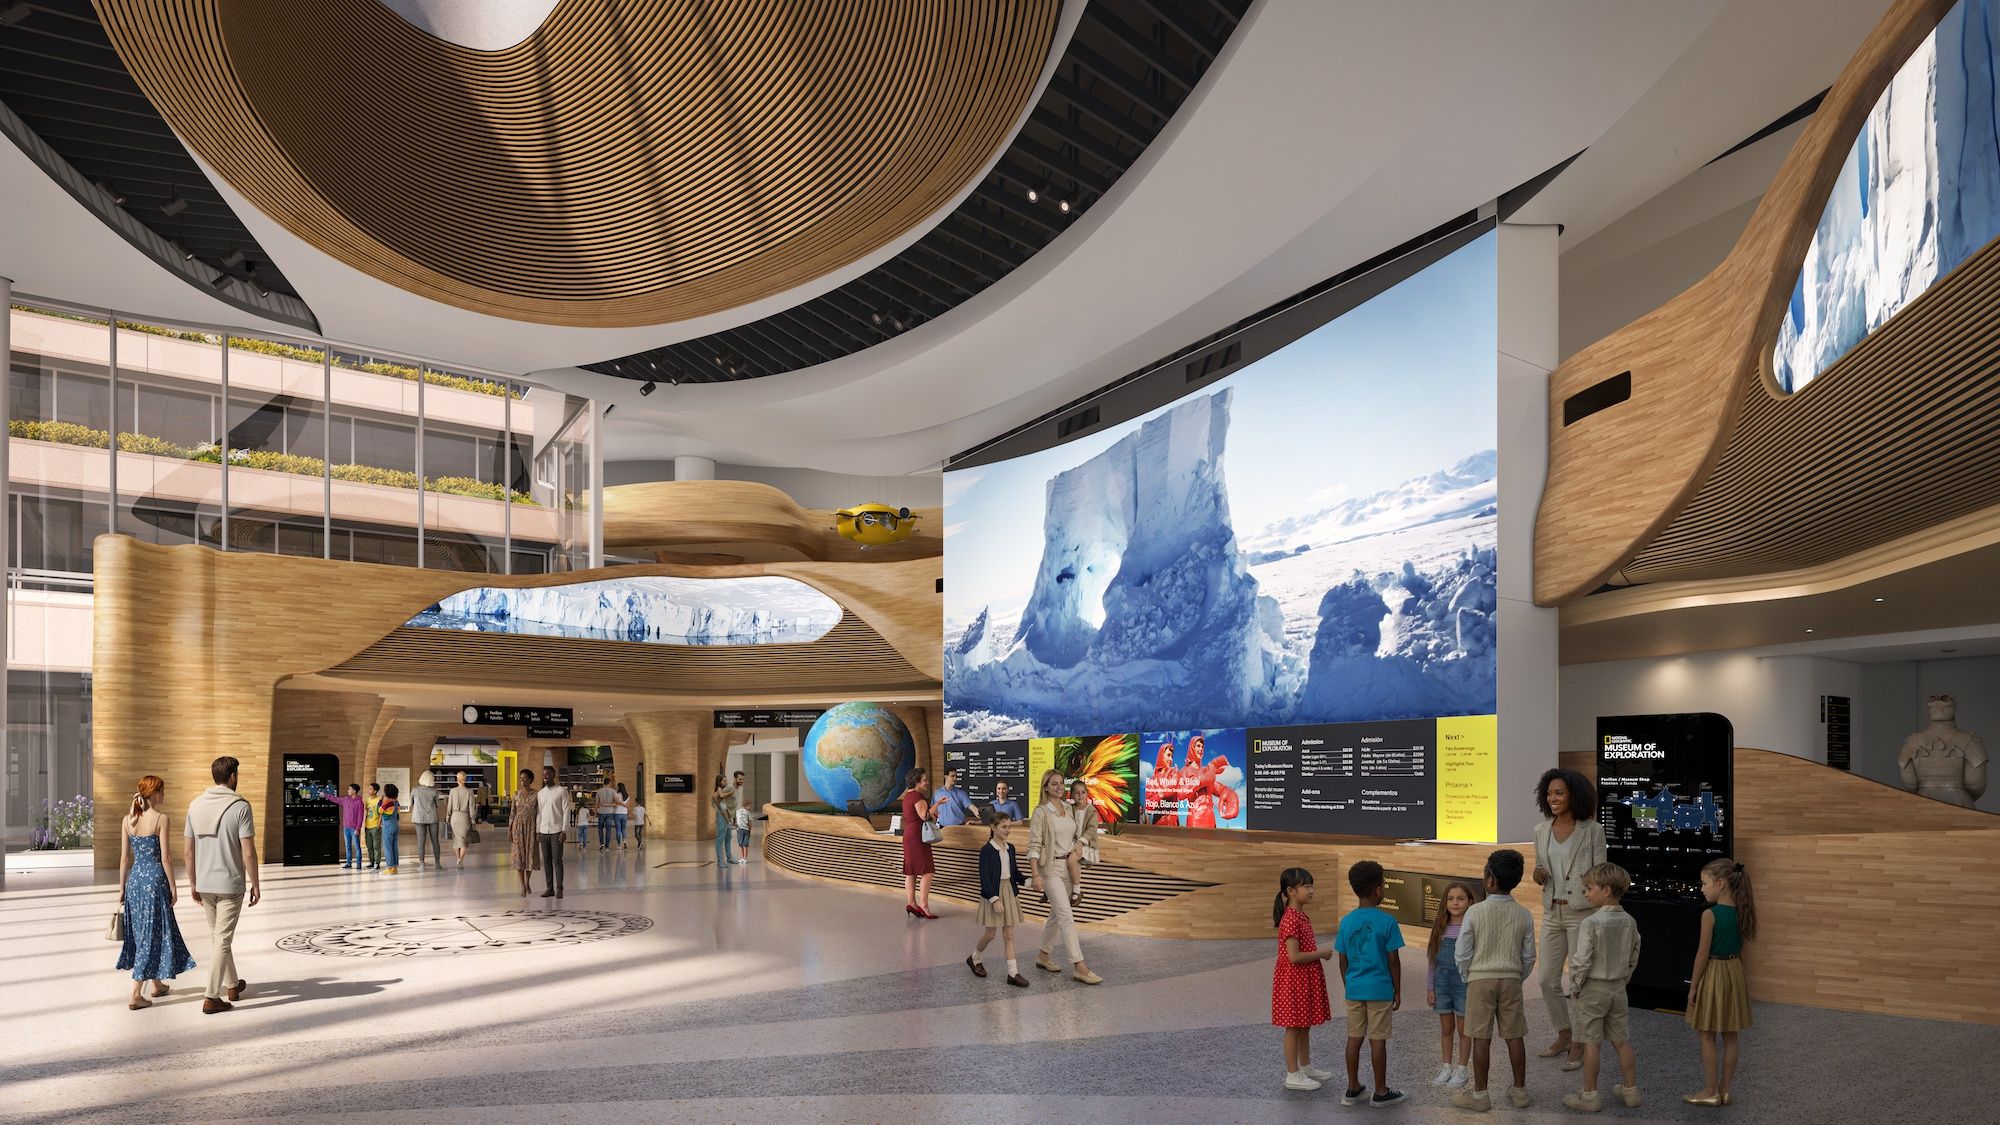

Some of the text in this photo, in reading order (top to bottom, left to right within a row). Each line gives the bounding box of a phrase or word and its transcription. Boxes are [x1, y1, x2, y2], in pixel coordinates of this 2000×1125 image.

[1605, 743, 1656, 751] MUSEUM OF
[1605, 751, 1665, 759] EXPLORATION
[1160, 778, 1177, 786] White
[1146, 799, 1159, 809] Rojo,
[1160, 800, 1179, 808] Blanco
